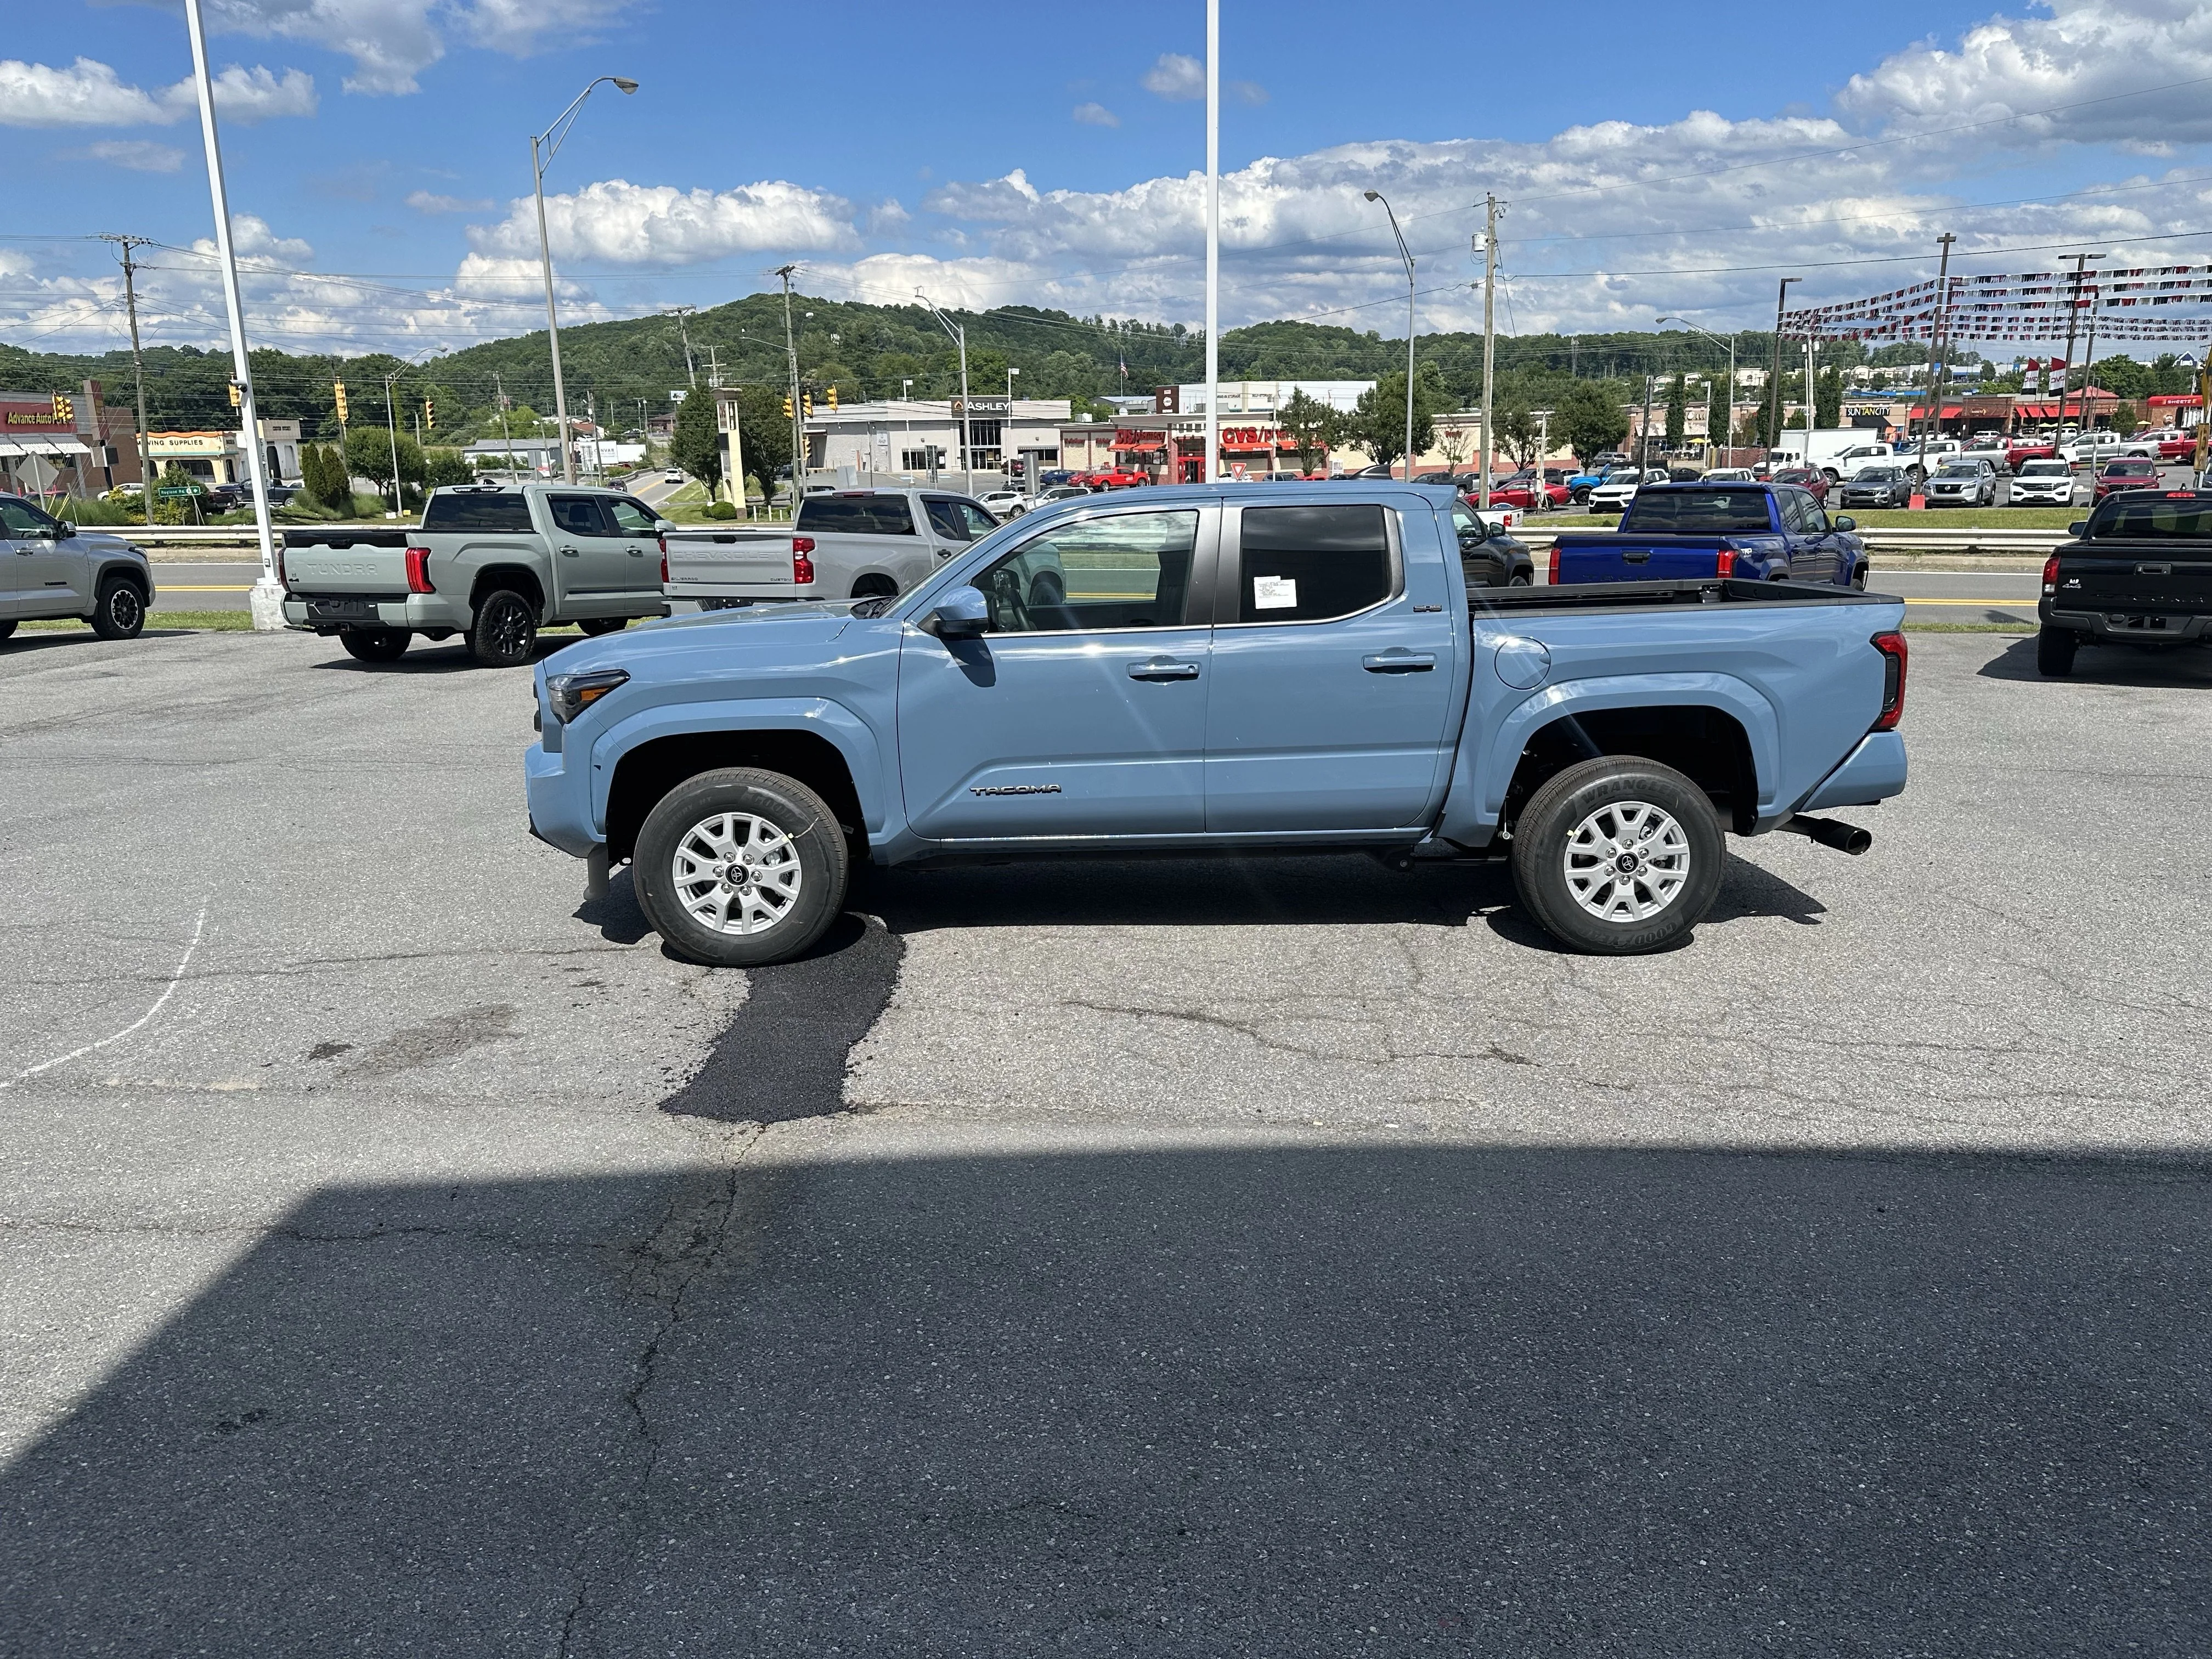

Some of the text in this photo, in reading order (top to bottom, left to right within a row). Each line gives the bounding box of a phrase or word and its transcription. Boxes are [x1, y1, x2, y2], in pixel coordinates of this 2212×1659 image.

[968, 401, 1009, 411] ASHLEY
[8, 411, 35, 425] Advance
[36, 412, 52, 425] Auto
[673, 551, 783, 560] CHEVROLET
[307, 563, 378, 575] TUNDRA
[969, 784, 1062, 796] TACOMA
[1581, 778, 1681, 804] WRANGLER
